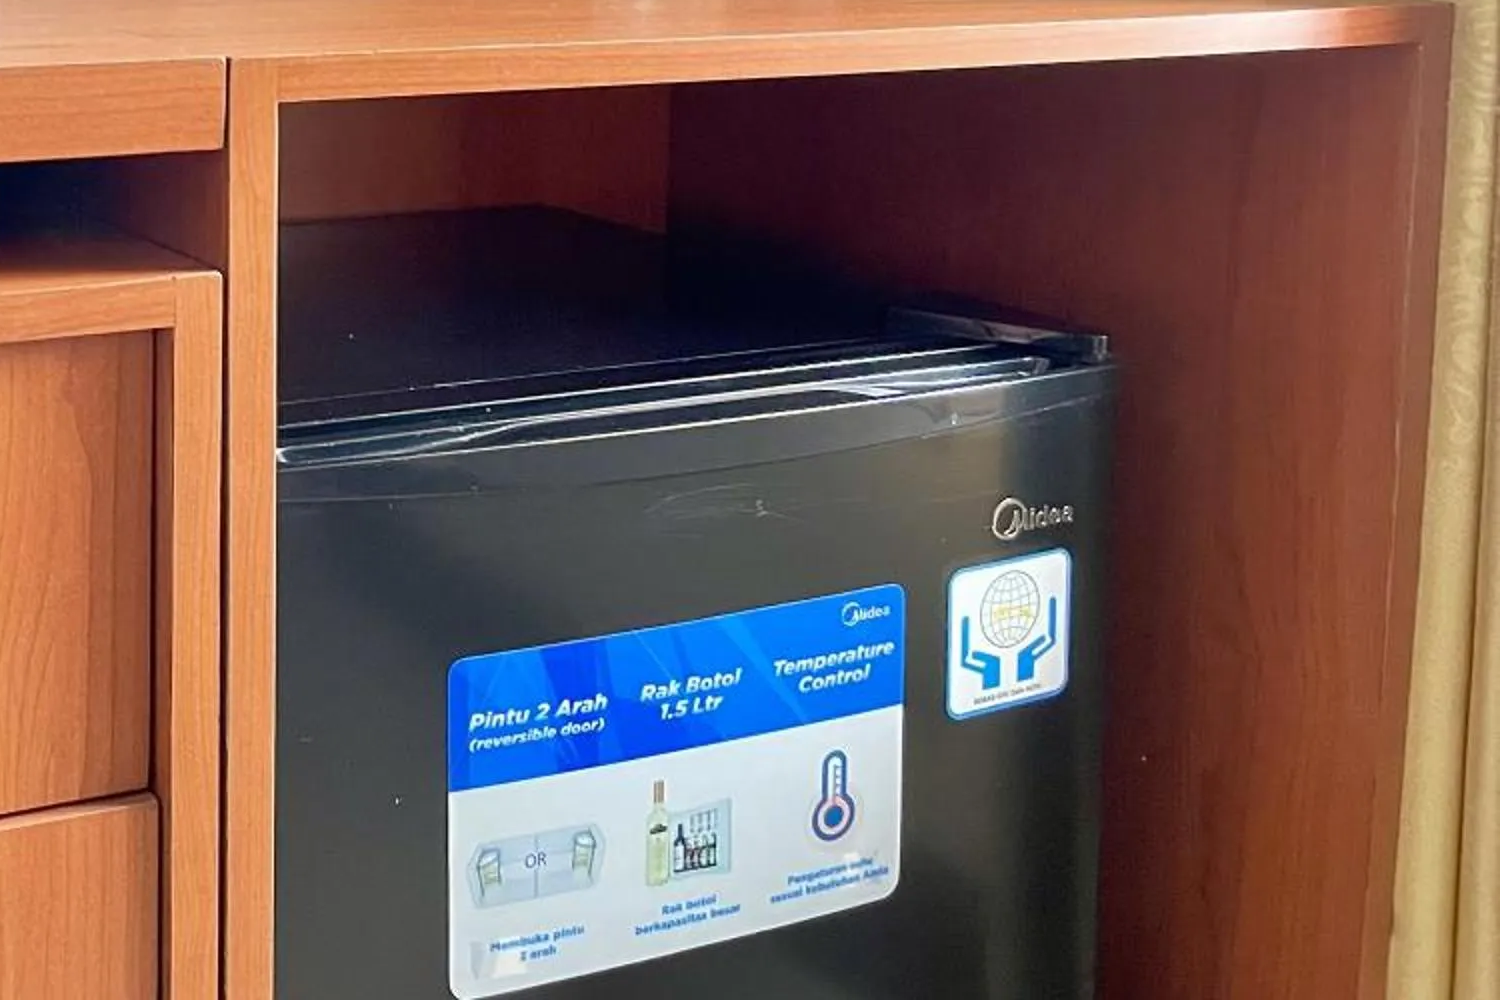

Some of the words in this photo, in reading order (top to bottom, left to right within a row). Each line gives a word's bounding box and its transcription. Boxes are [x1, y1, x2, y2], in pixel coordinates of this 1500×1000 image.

[991, 496, 1075, 541] Midea
[841, 600, 892, 628] Midea
[772, 640, 896, 677] Temperature
[640, 678, 682, 703] Rak
[685, 666, 744, 694] Botol
[797, 662, 872, 694] Control
[467, 707, 532, 732] Pintu
[534, 701, 551, 722] 2
[555, 692, 609, 719] Arah
[660, 698, 690, 721] 1.5
[691, 694, 725, 715] Ltr
[468, 725, 557, 754] (reversible
[560, 716, 606, 737] door)
[524, 850, 548, 870] OR
